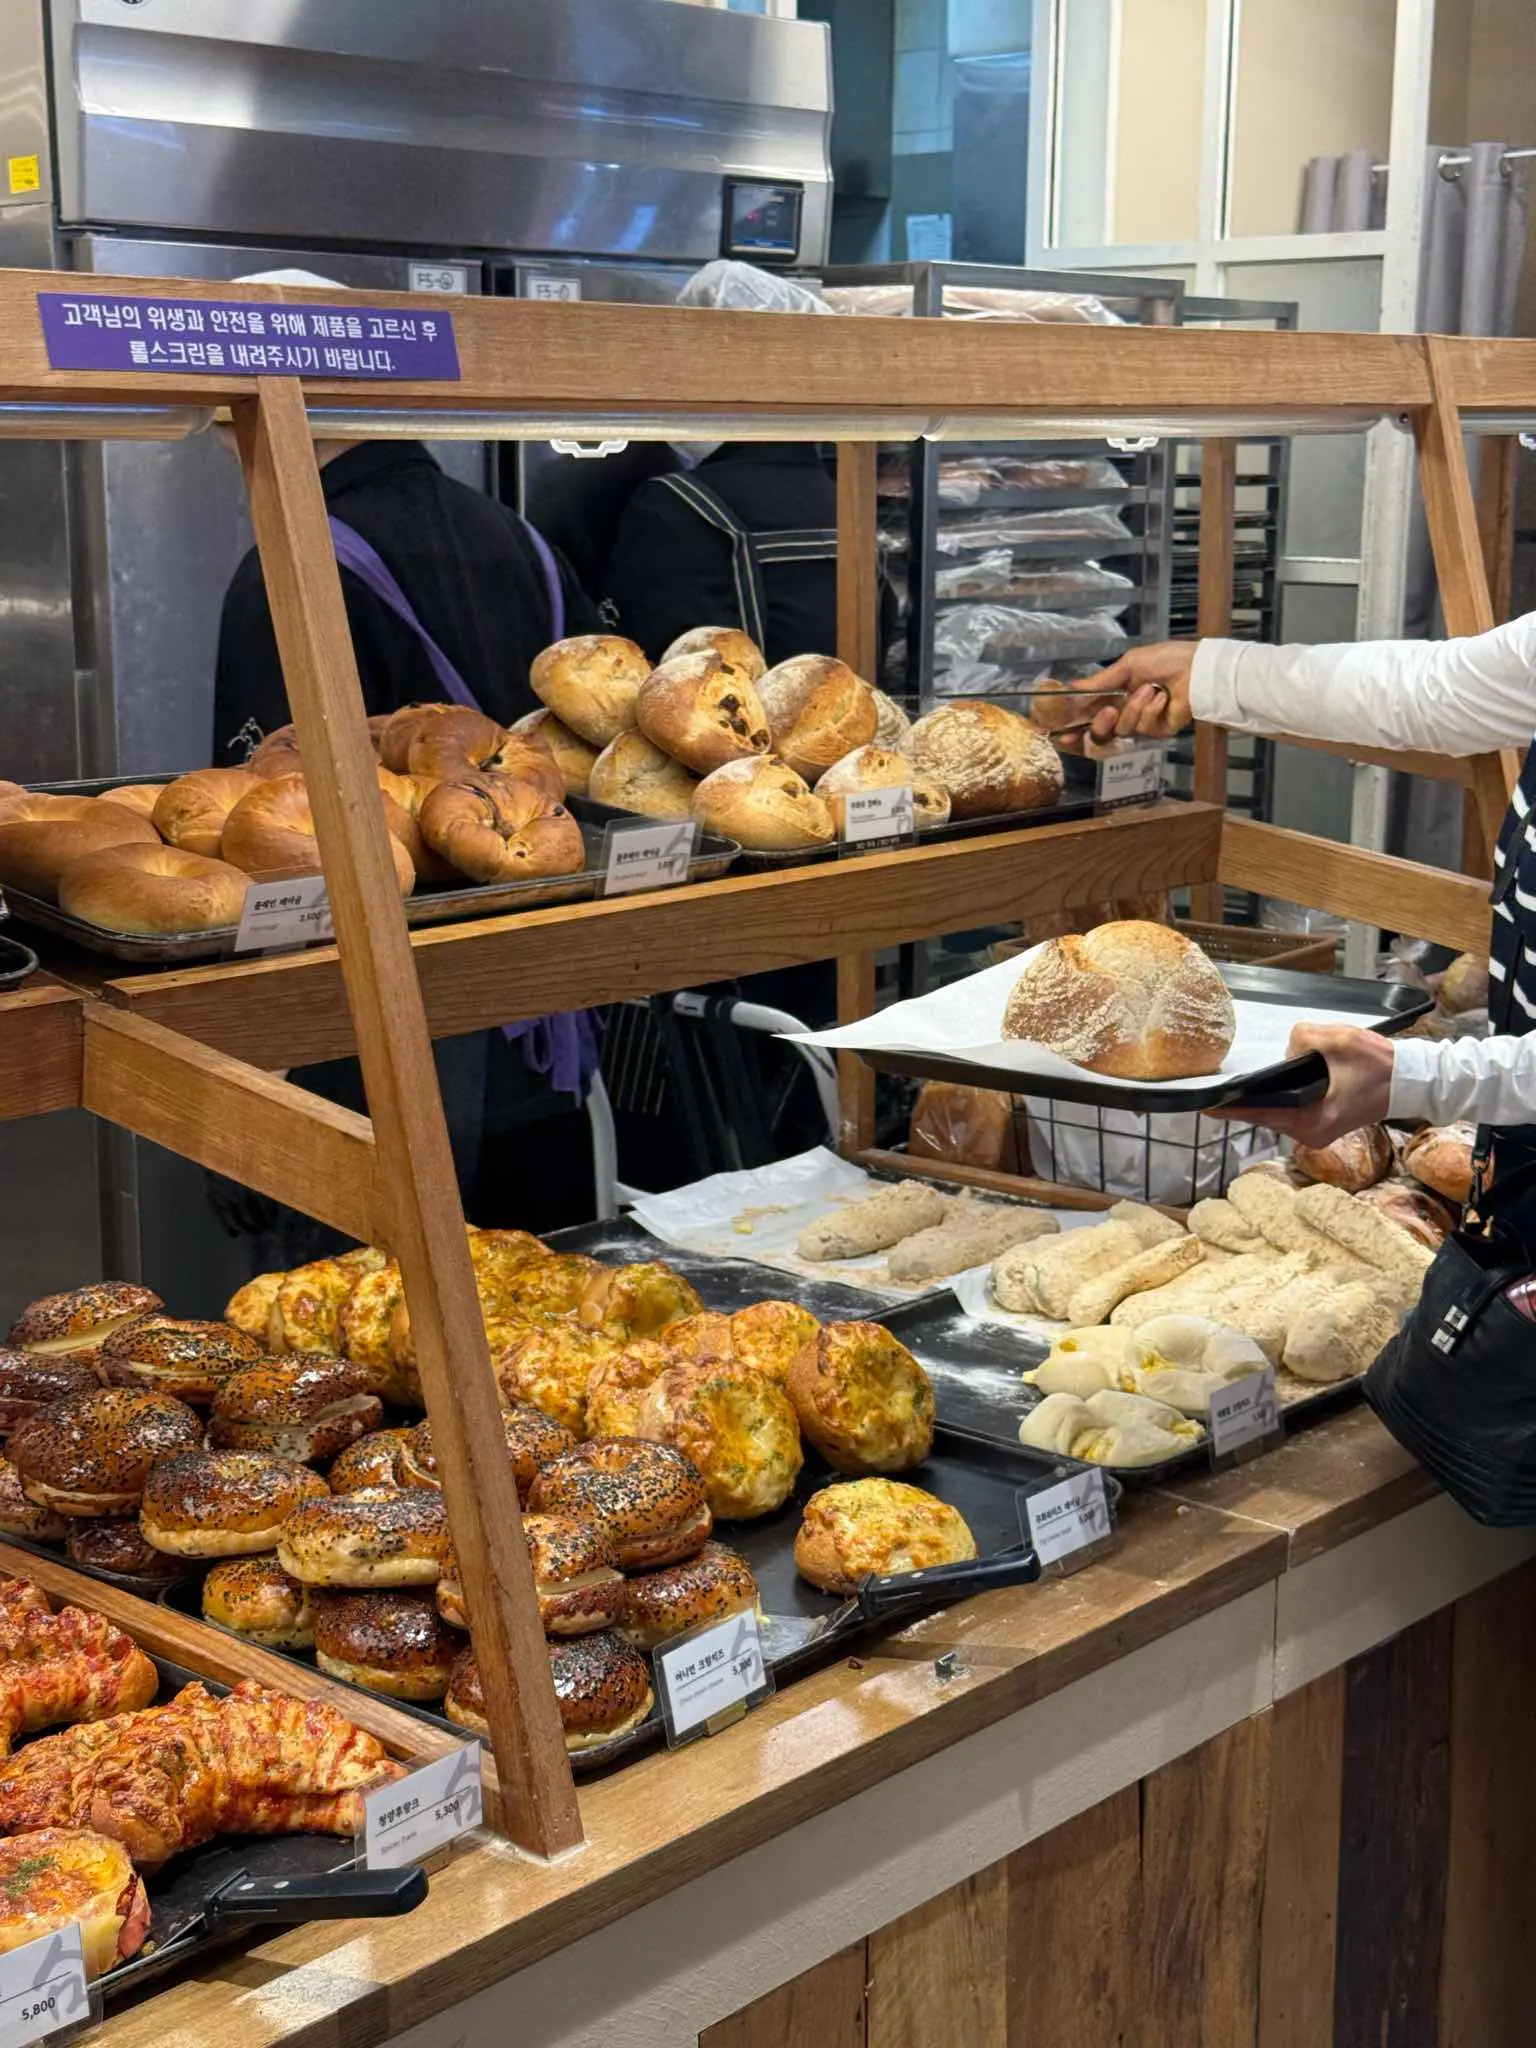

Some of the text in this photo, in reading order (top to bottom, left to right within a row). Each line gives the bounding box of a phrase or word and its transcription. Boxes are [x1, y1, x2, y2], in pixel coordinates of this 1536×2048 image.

[62, 303, 438, 342] 고객님의 위생과 안전을 위해 제품을 고르신 후
[129, 340, 396, 372] 롤스크린을 내려주시기 바랍니다.
[279, 895, 302, 906] 베이글
[675, 1649, 725, 1681] 어니언 크림치즈
[434, 1800, 460, 1821] 5,300
[22, 1997, 56, 2021] 5,800
